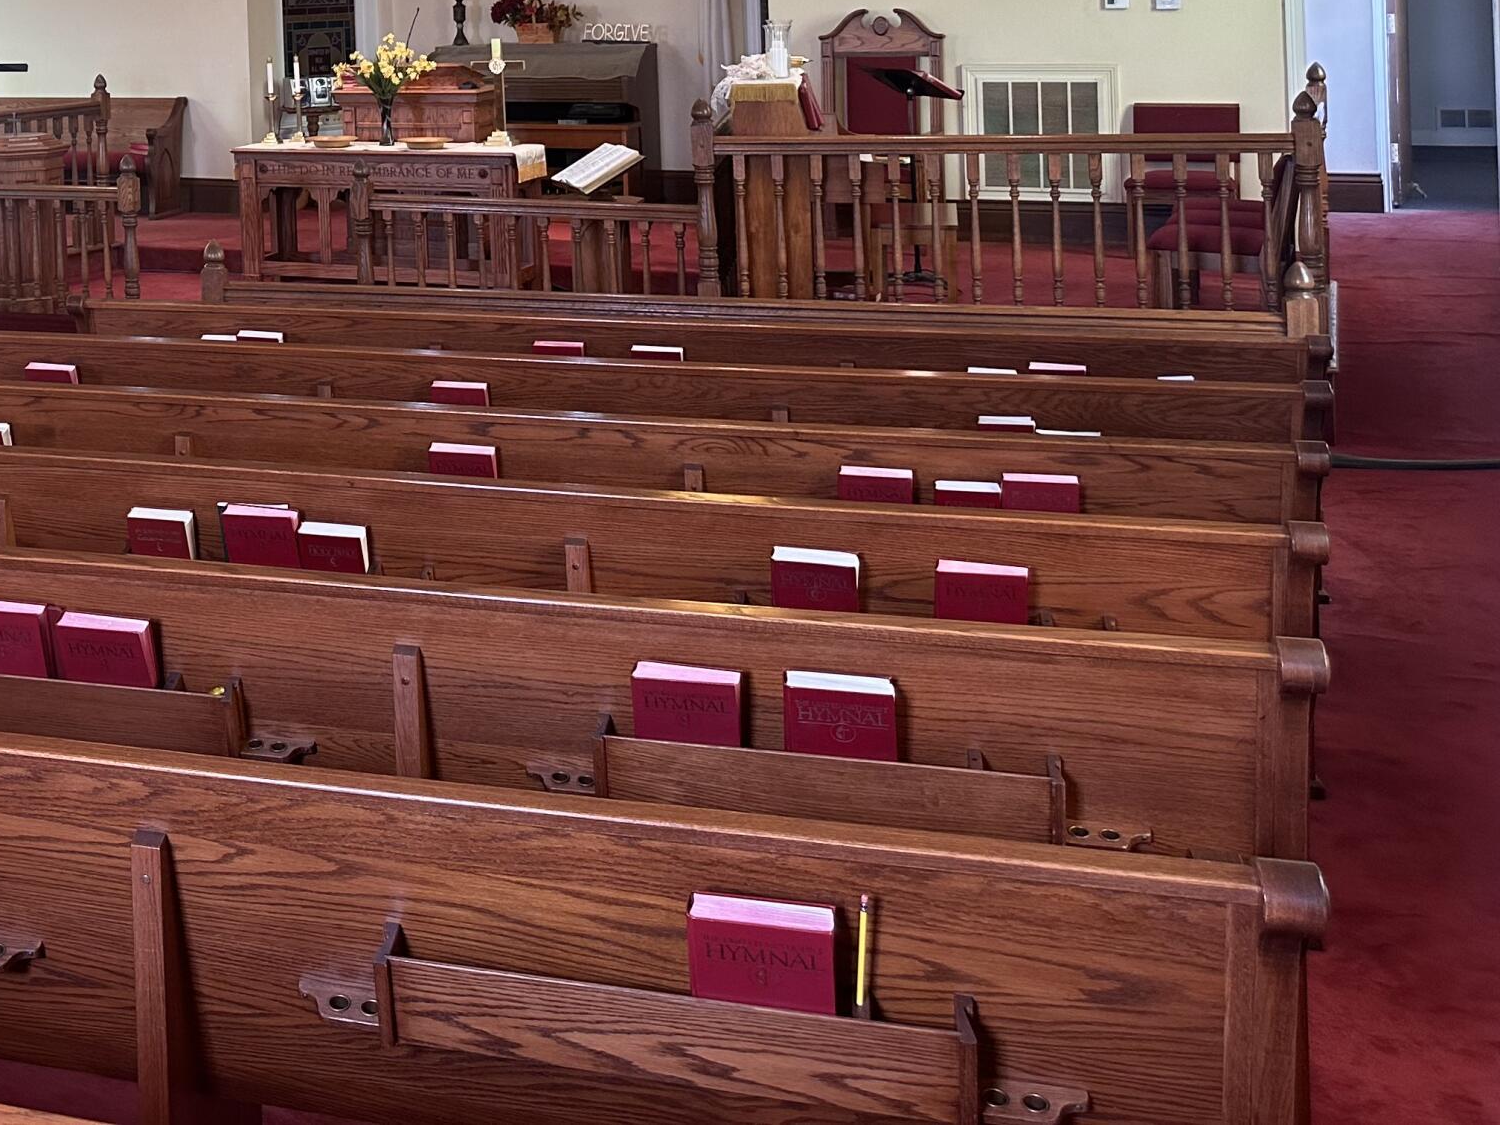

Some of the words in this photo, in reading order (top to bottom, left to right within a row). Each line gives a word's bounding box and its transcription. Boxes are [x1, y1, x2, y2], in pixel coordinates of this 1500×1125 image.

[583, 22, 650, 42] FORGIVE
[300, 165, 318, 175] DO
[322, 165, 335, 175] IN
[339, 165, 431, 179] REMBRANCE
[436, 167, 453, 179] OF
[456, 167, 476, 179] ME
[643, 694, 729, 715] HYMNAL
[797, 706, 887, 726] HYMNAL
[706, 941, 818, 971] HYMNAL
